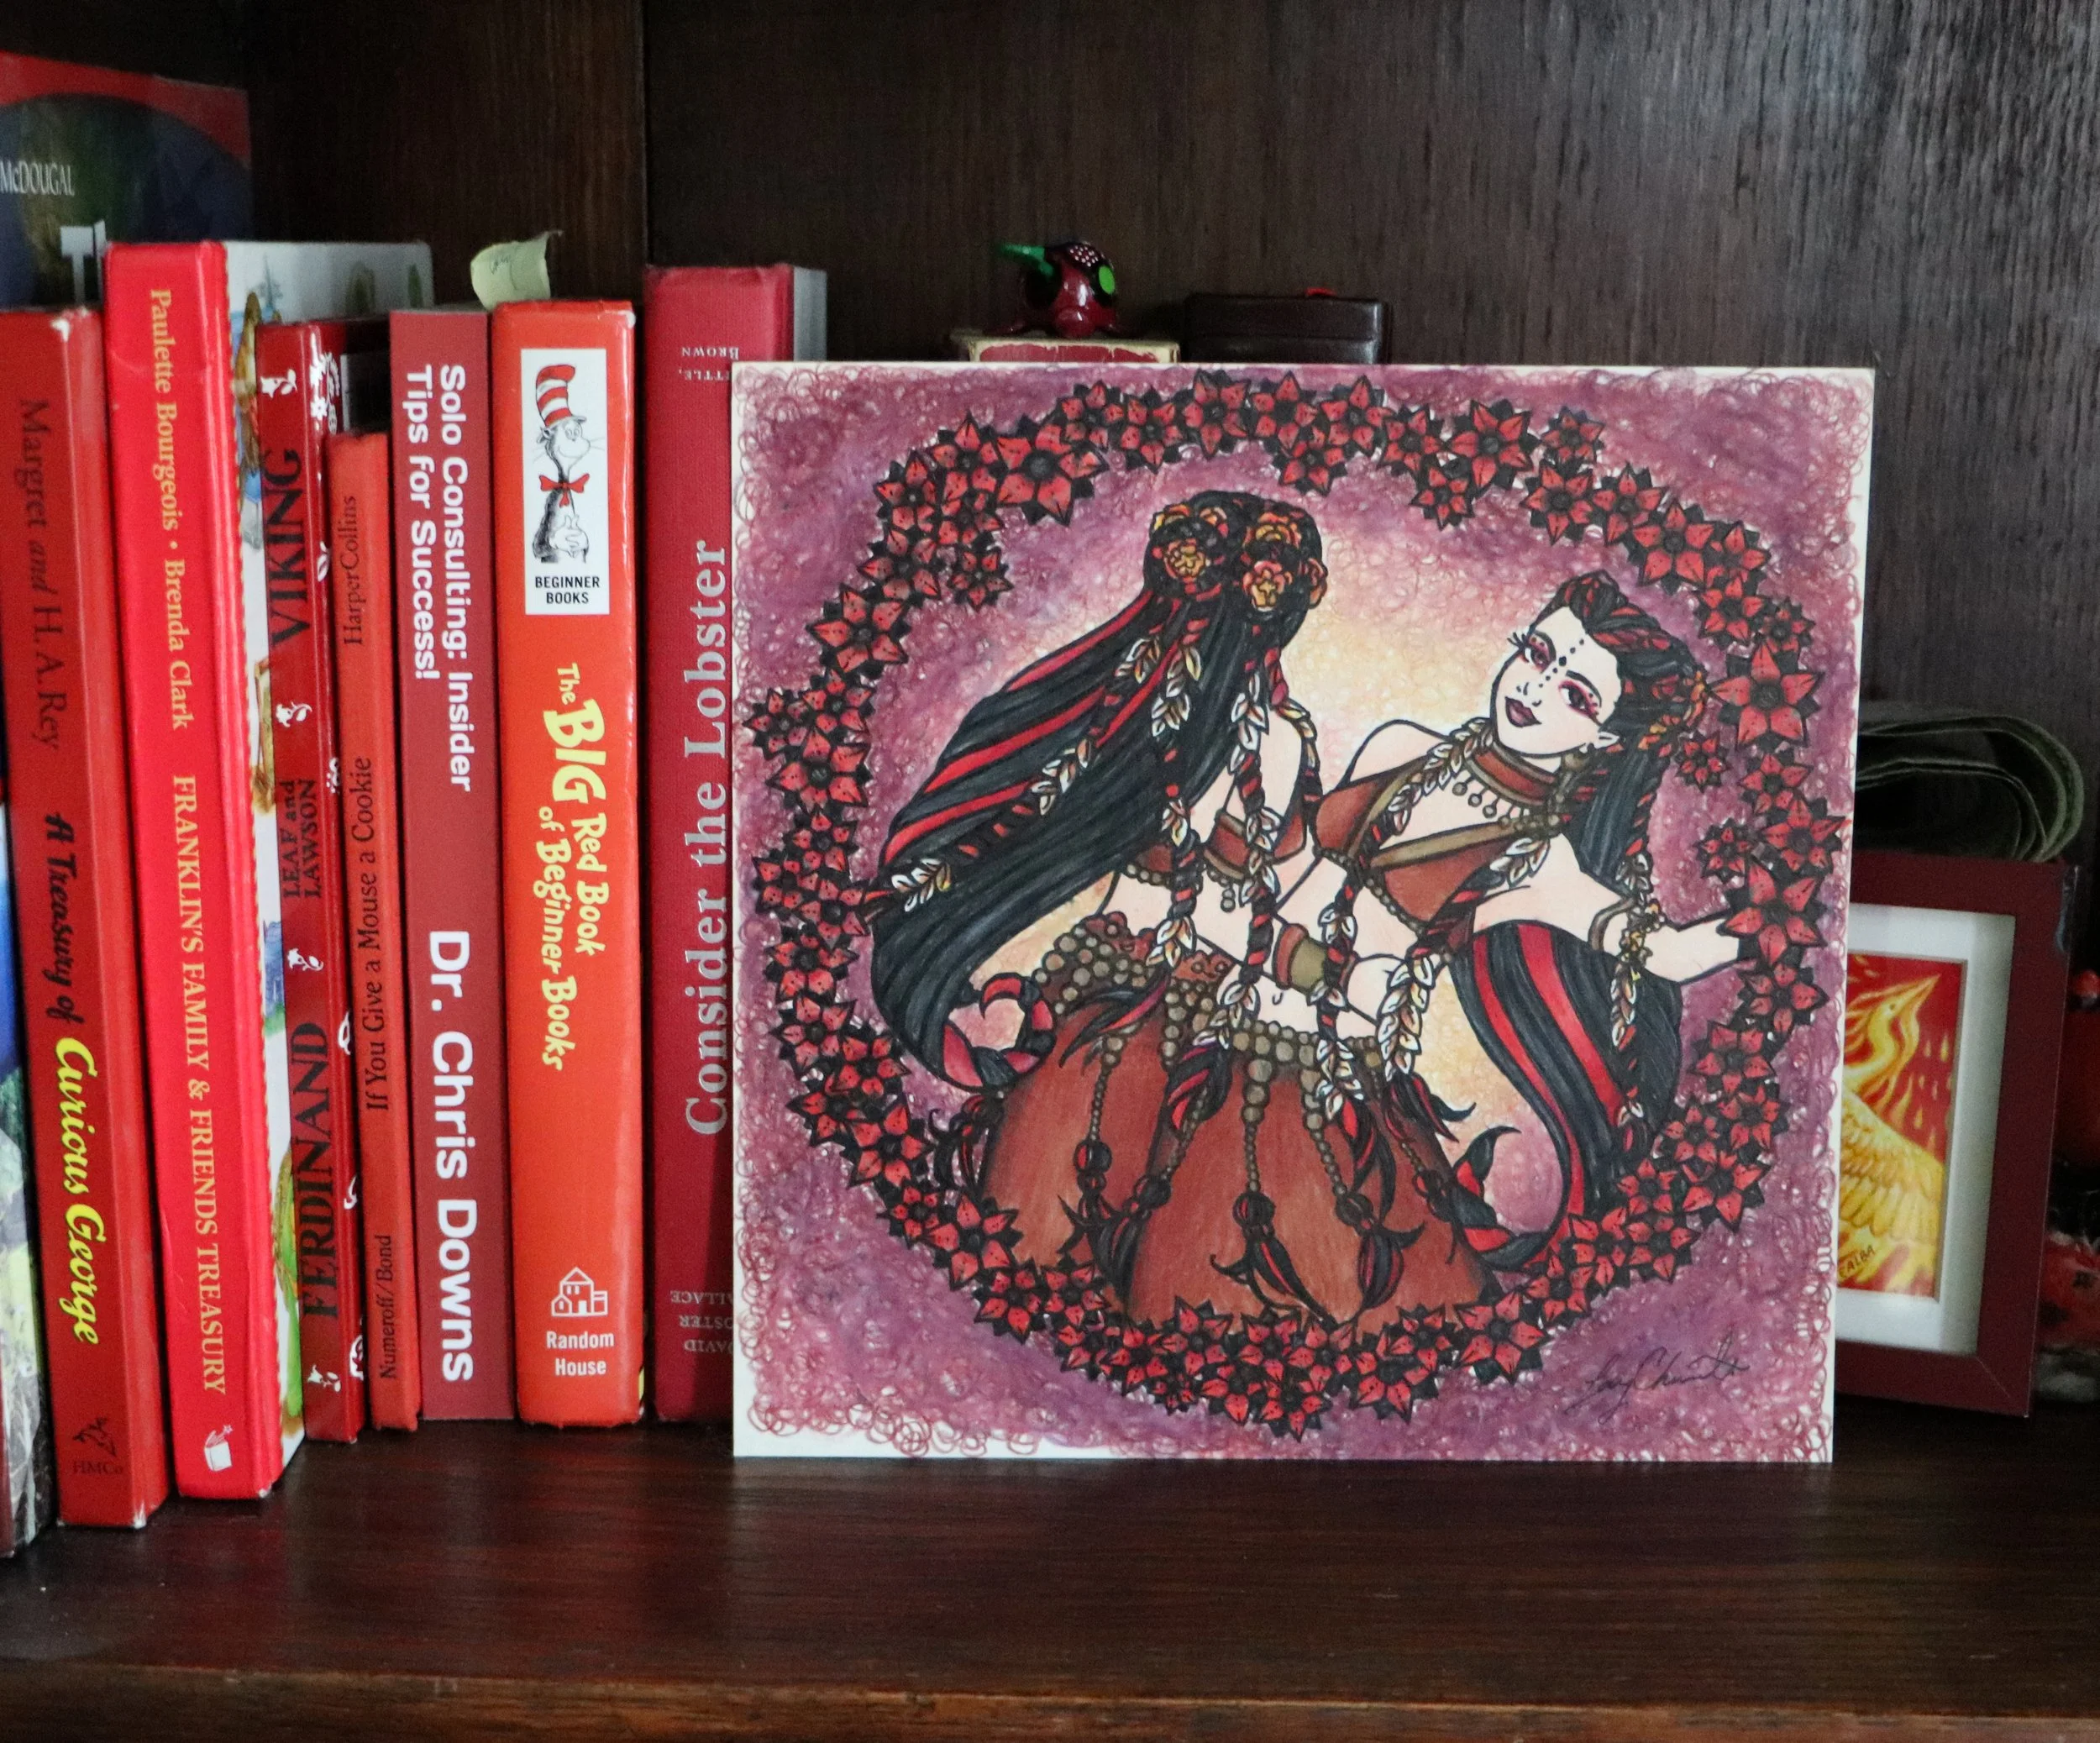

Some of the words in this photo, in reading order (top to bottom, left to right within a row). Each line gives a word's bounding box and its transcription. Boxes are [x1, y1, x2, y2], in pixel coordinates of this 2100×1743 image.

[0, 160, 75, 196] McDOUGAL
[150, 289, 176, 393] Paulette
[402, 365, 432, 444] Tips
[440, 365, 466, 445] Solo
[14, 400, 50, 528] Margret
[153, 402, 182, 531] Bourgeois
[409, 456, 434, 509] for
[29, 540, 57, 595] and
[264, 448, 311, 646] VIKING
[339, 496, 363, 645] HarperCollins
[441, 456, 471, 659] Consulting:
[535, 576, 600, 589] BEGINNER
[165, 559, 189, 652] Brenda
[411, 520, 440, 680] Success!
[546, 591, 589, 604] BOOKS
[556, 662, 581, 705] The
[683, 539, 727, 759] Lobster
[31, 691, 67, 748] Rey
[171, 660, 195, 731] Clark
[448, 672, 475, 791] Insider
[543, 698, 607, 805] BIG
[45, 812, 75, 841] A
[281, 780, 297, 819] and
[298, 778, 322, 899] LAWSON
[349, 757, 375, 842] Cookie
[538, 806, 565, 833] of
[684, 781, 727, 869] the
[173, 775, 204, 953] FRANKLIN'S
[280, 830, 302, 899] LEAF
[360, 851, 375, 864] a
[571, 812, 608, 873] Red
[42, 853, 77, 987] Treasury
[357, 871, 381, 950] Mouse
[533, 838, 572, 975] Beginner
[575, 880, 610, 956] Book
[362, 981, 384, 1033] Give
[365, 960, 381, 973] a
[428, 930, 470, 1011] Dr.
[45, 995, 85, 1024] of
[181, 963, 209, 1070] FAMILY
[541, 976, 578, 1070] Books
[685, 888, 728, 1136] Consider
[187, 1079, 210, 1100] &
[365, 1042, 388, 1085] You
[365, 1087, 389, 1111] If
[55, 1037, 97, 1194] Curious
[433, 1032, 475, 1179] Chris
[189, 1109, 218, 1234] FRIENDS
[290, 1021, 339, 1319] FERDINAND
[59, 1203, 107, 1345] George
[438, 1200, 477, 1382] Downs
[197, 1243, 226, 1394] TREASURY
[546, 1331, 614, 1349] Random
[678, 1315, 733, 1330] OSTER
[554, 1357, 606, 1376] House
